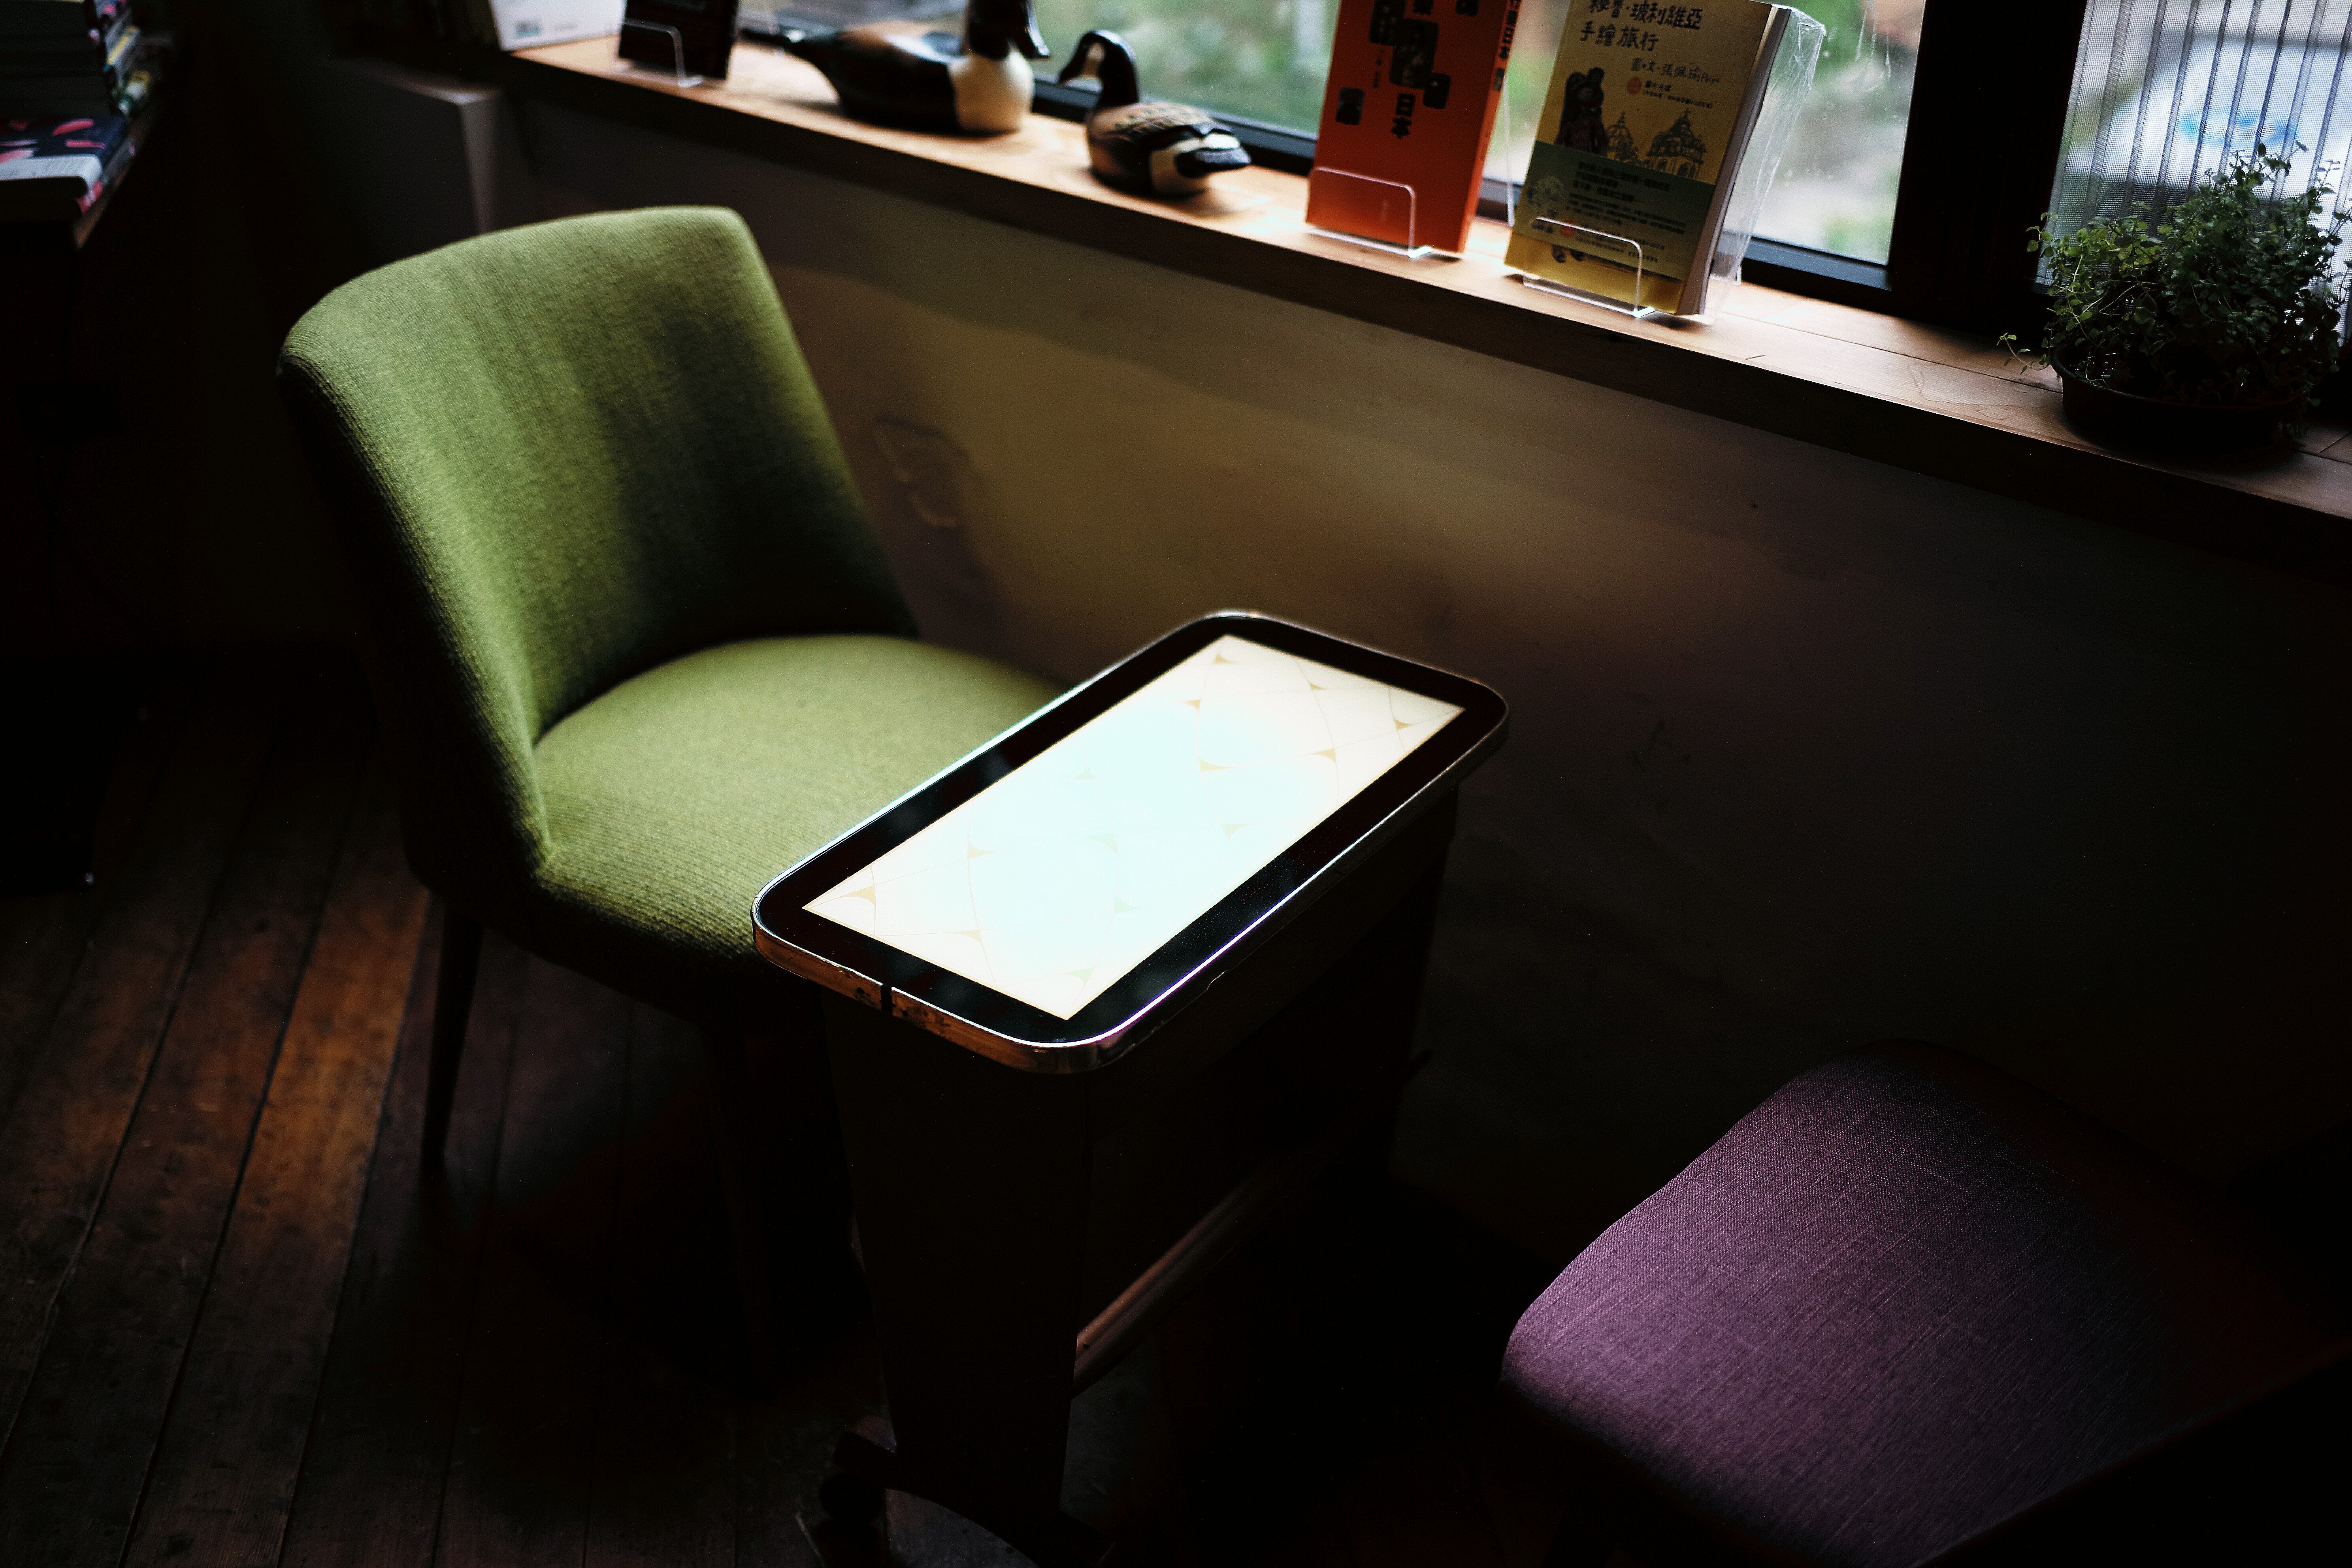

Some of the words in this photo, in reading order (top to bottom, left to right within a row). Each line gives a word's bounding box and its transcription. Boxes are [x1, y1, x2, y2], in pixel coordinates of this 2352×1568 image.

[1580, 21, 1659, 51] 手繪旅行
[1391, 92, 1416, 140] 日本
